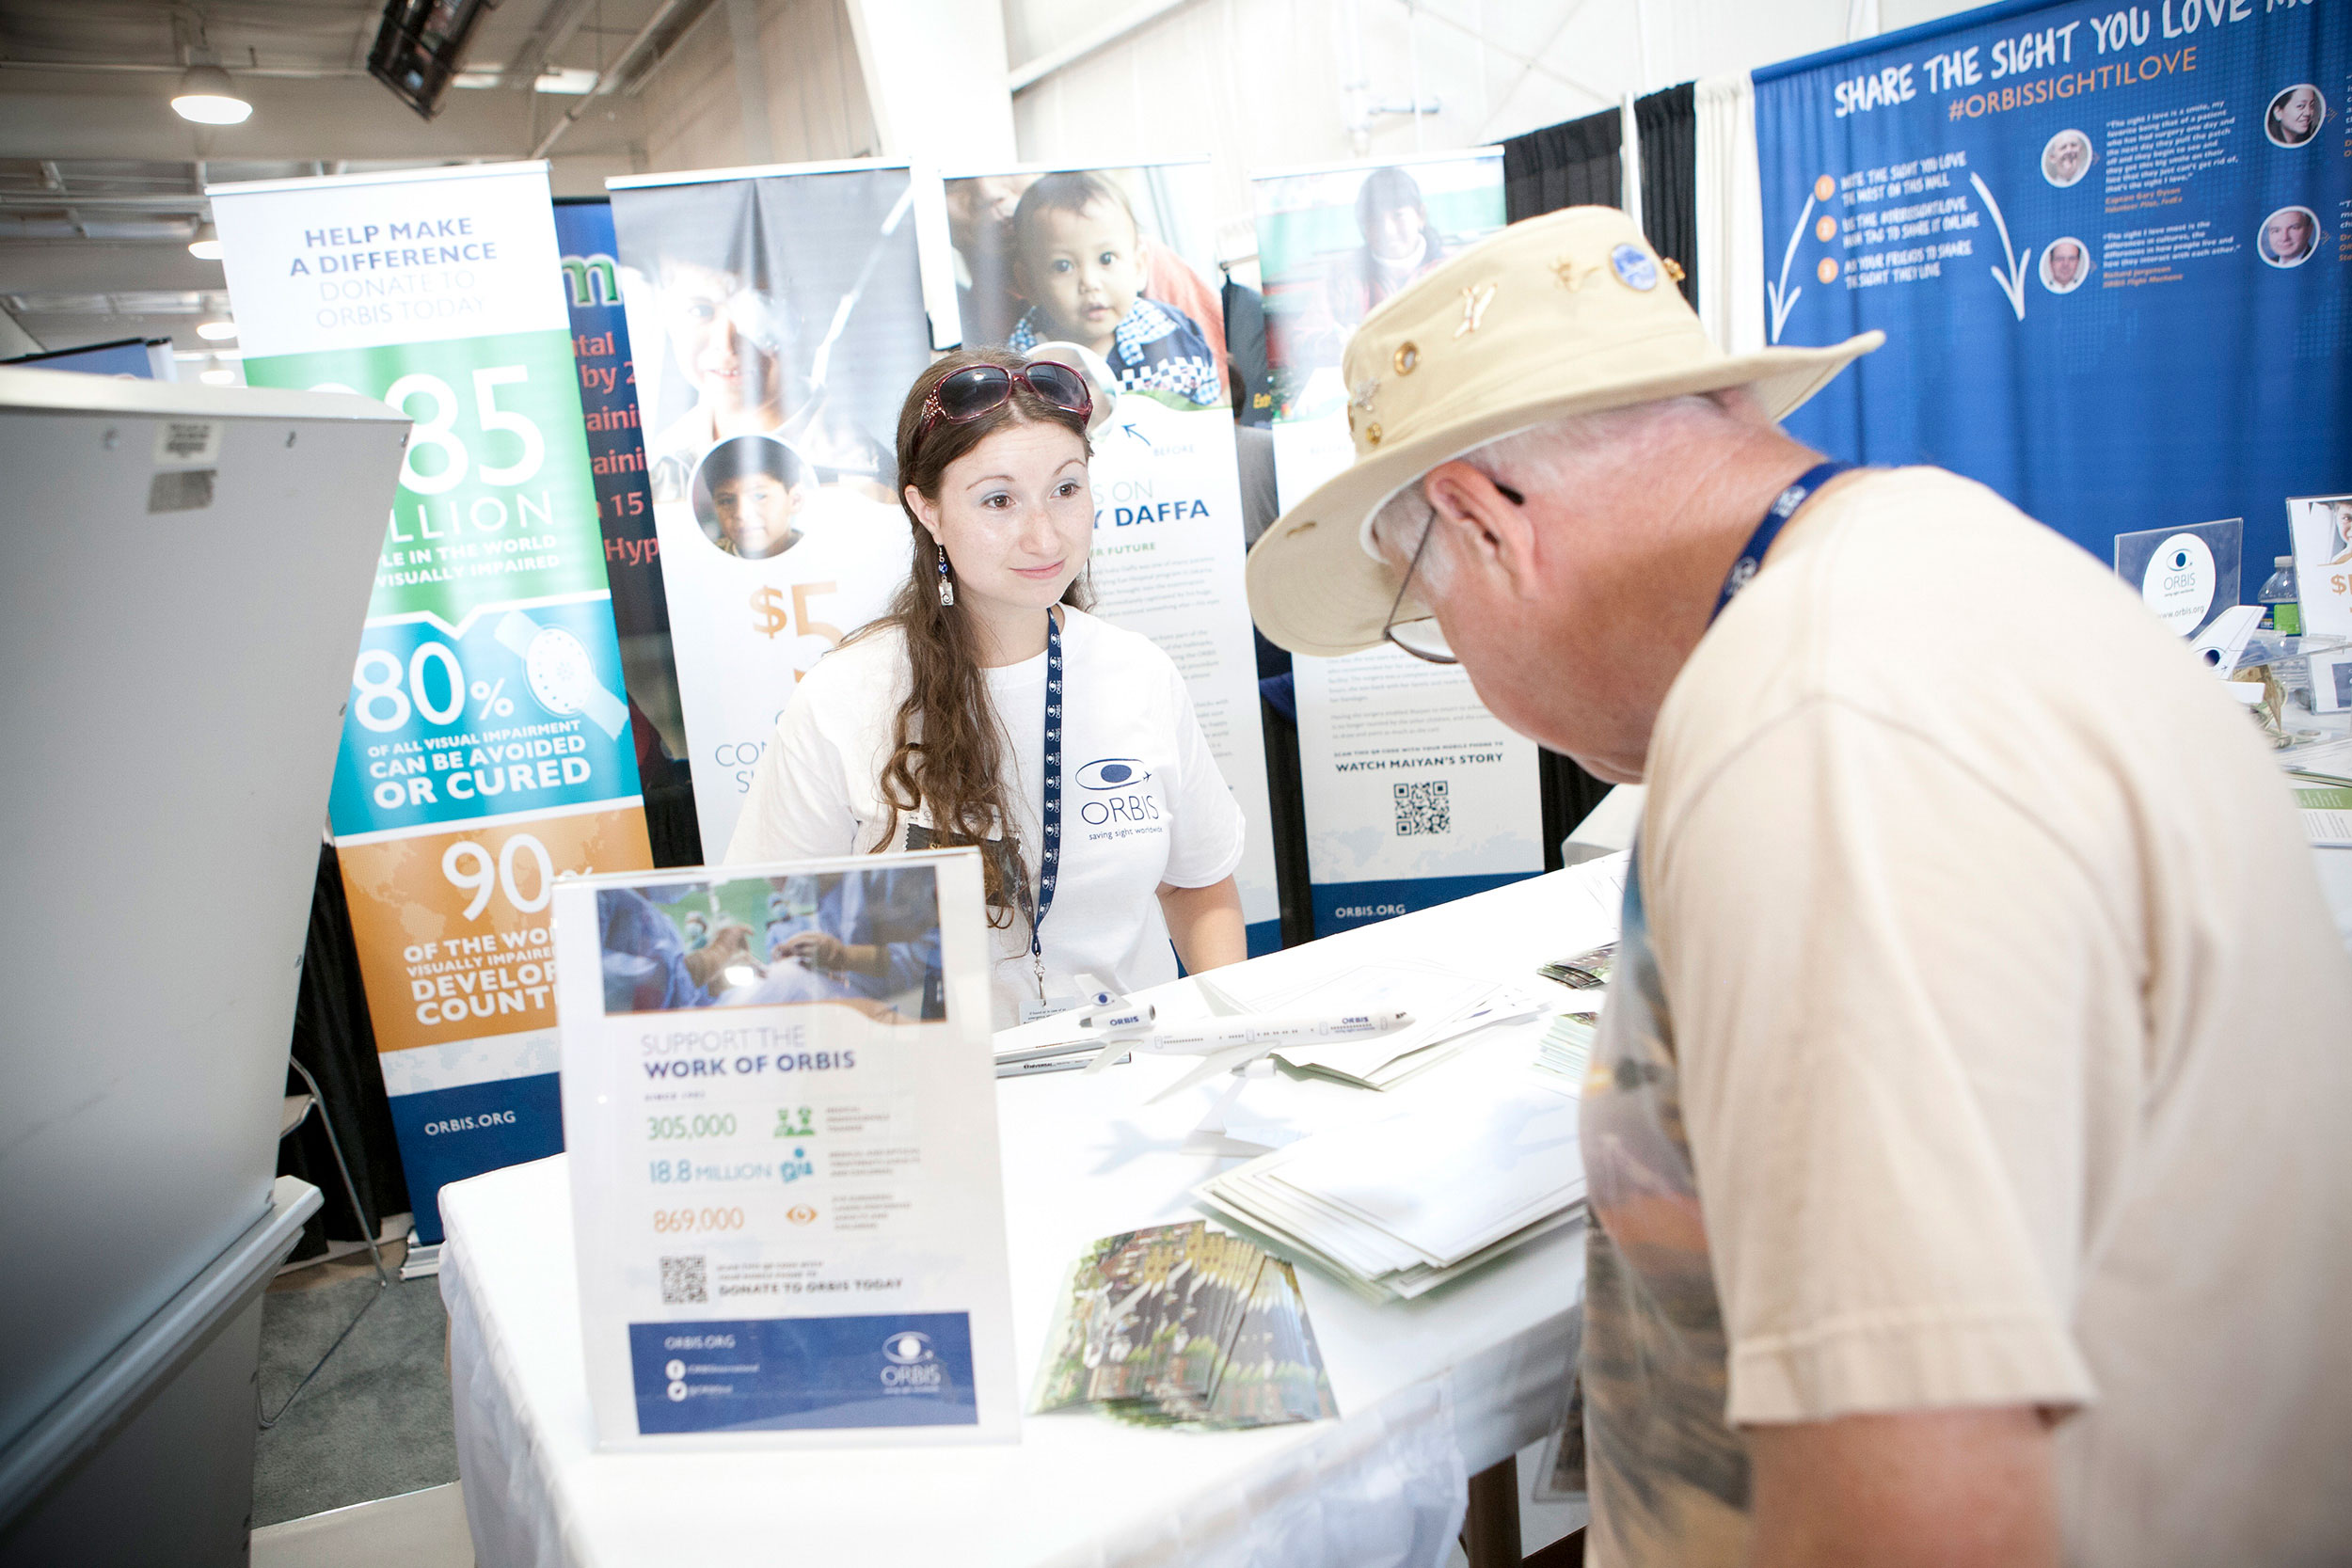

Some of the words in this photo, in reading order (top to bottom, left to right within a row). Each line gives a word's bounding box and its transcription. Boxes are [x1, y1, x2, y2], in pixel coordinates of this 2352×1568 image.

[1835, 63, 1916, 118] SHARE
[1924, 46, 1982, 94] THE
[1990, 21, 2080, 79] SIGHT
[2090, 6, 2150, 55] YOU
[2162, 0, 2252, 39] LOVE
[1947, 47, 2198, 121] #ORBISSIGHTILOVE
[2212, 101, 2224, 109] my
[2203, 121, 2218, 131] day
[2219, 117, 2235, 126] and
[305, 225, 380, 248] HELP
[389, 217, 473, 241] MAKE
[290, 258, 310, 277] A
[319, 242, 498, 274] DIFFERENCE
[320, 274, 434, 302] DONATE
[442, 270, 475, 289] TO
[316, 303, 392, 328] ORBIS
[397, 297, 485, 321] TODAY
[581, 364, 618, 395] by
[308, 364, 546, 496] 85
[585, 404, 642, 432] aini
[592, 447, 647, 475] aini
[611, 491, 644, 517] 15
[1091, 483, 1104, 505] S
[1112, 479, 1152, 503] ON
[389, 490, 555, 543] LLION
[1115, 499, 1210, 527] DAFFA
[381, 552, 405, 567] LE
[409, 549, 432, 564] IN
[437, 544, 482, 561] THE
[484, 536, 556, 555] WORLD
[604, 536, 660, 566] Hyp
[1108, 542, 1156, 555] FUTURE
[377, 566, 464, 587] VISUALLY
[471, 555, 560, 577] IMPAIRED
[2164, 573, 2196, 591] ORBIS
[2160, 606, 2204, 618] ww.orbis.org
[353, 641, 514, 734] 80%
[368, 745, 389, 758] OF
[392, 740, 421, 755] ALL
[424, 733, 480, 750] VISUAL
[483, 720, 580, 744] IMPAIRMENT
[715, 740, 767, 767] CO
[369, 753, 427, 779] CAN
[432, 750, 464, 770] BE
[469, 734, 586, 764] AVOIDED
[1335, 760, 1386, 772] WATCH
[1390, 756, 1455, 768] MAIYAN'S
[1459, 752, 1503, 764] STORY
[373, 781, 437, 809] OR
[446, 756, 592, 800] CURED
[736, 770, 755, 793] S
[1081, 795, 1159, 825] ORBIS
[1089, 831, 1113, 841] saving
[1115, 828, 1133, 838] sight
[1335, 904, 1406, 919] ORBIS.ORG
[403, 942, 438, 963] OF
[444, 935, 497, 957] THE
[501, 927, 556, 949] WO
[406, 956, 483, 978] VISUALLY
[487, 945, 556, 967] IMPAIRE
[416, 987, 558, 1025] COUNT
[1342, 1016, 1369, 1024] ORBIS
[1110, 1016, 1139, 1026] ORBIS
[641, 1029, 752, 1057] SUPPORT
[755, 1024, 807, 1049] THE
[644, 1058, 726, 1080] WORK
[735, 1055, 769, 1075] OF
[775, 1050, 856, 1073] ORBIS
[424, 1111, 516, 1136] ORBIS.ORG
[646, 1114, 738, 1141] 305,000
[648, 1159, 692, 1184] 18.8
[695, 1163, 772, 1181] MILLION
[654, 1206, 745, 1233] 869,000
[720, 1282, 779, 1296] DONATE
[784, 1282, 803, 1293] TO
[805, 1280, 850, 1293] ORBIS
[854, 1278, 903, 1291] TODAY
